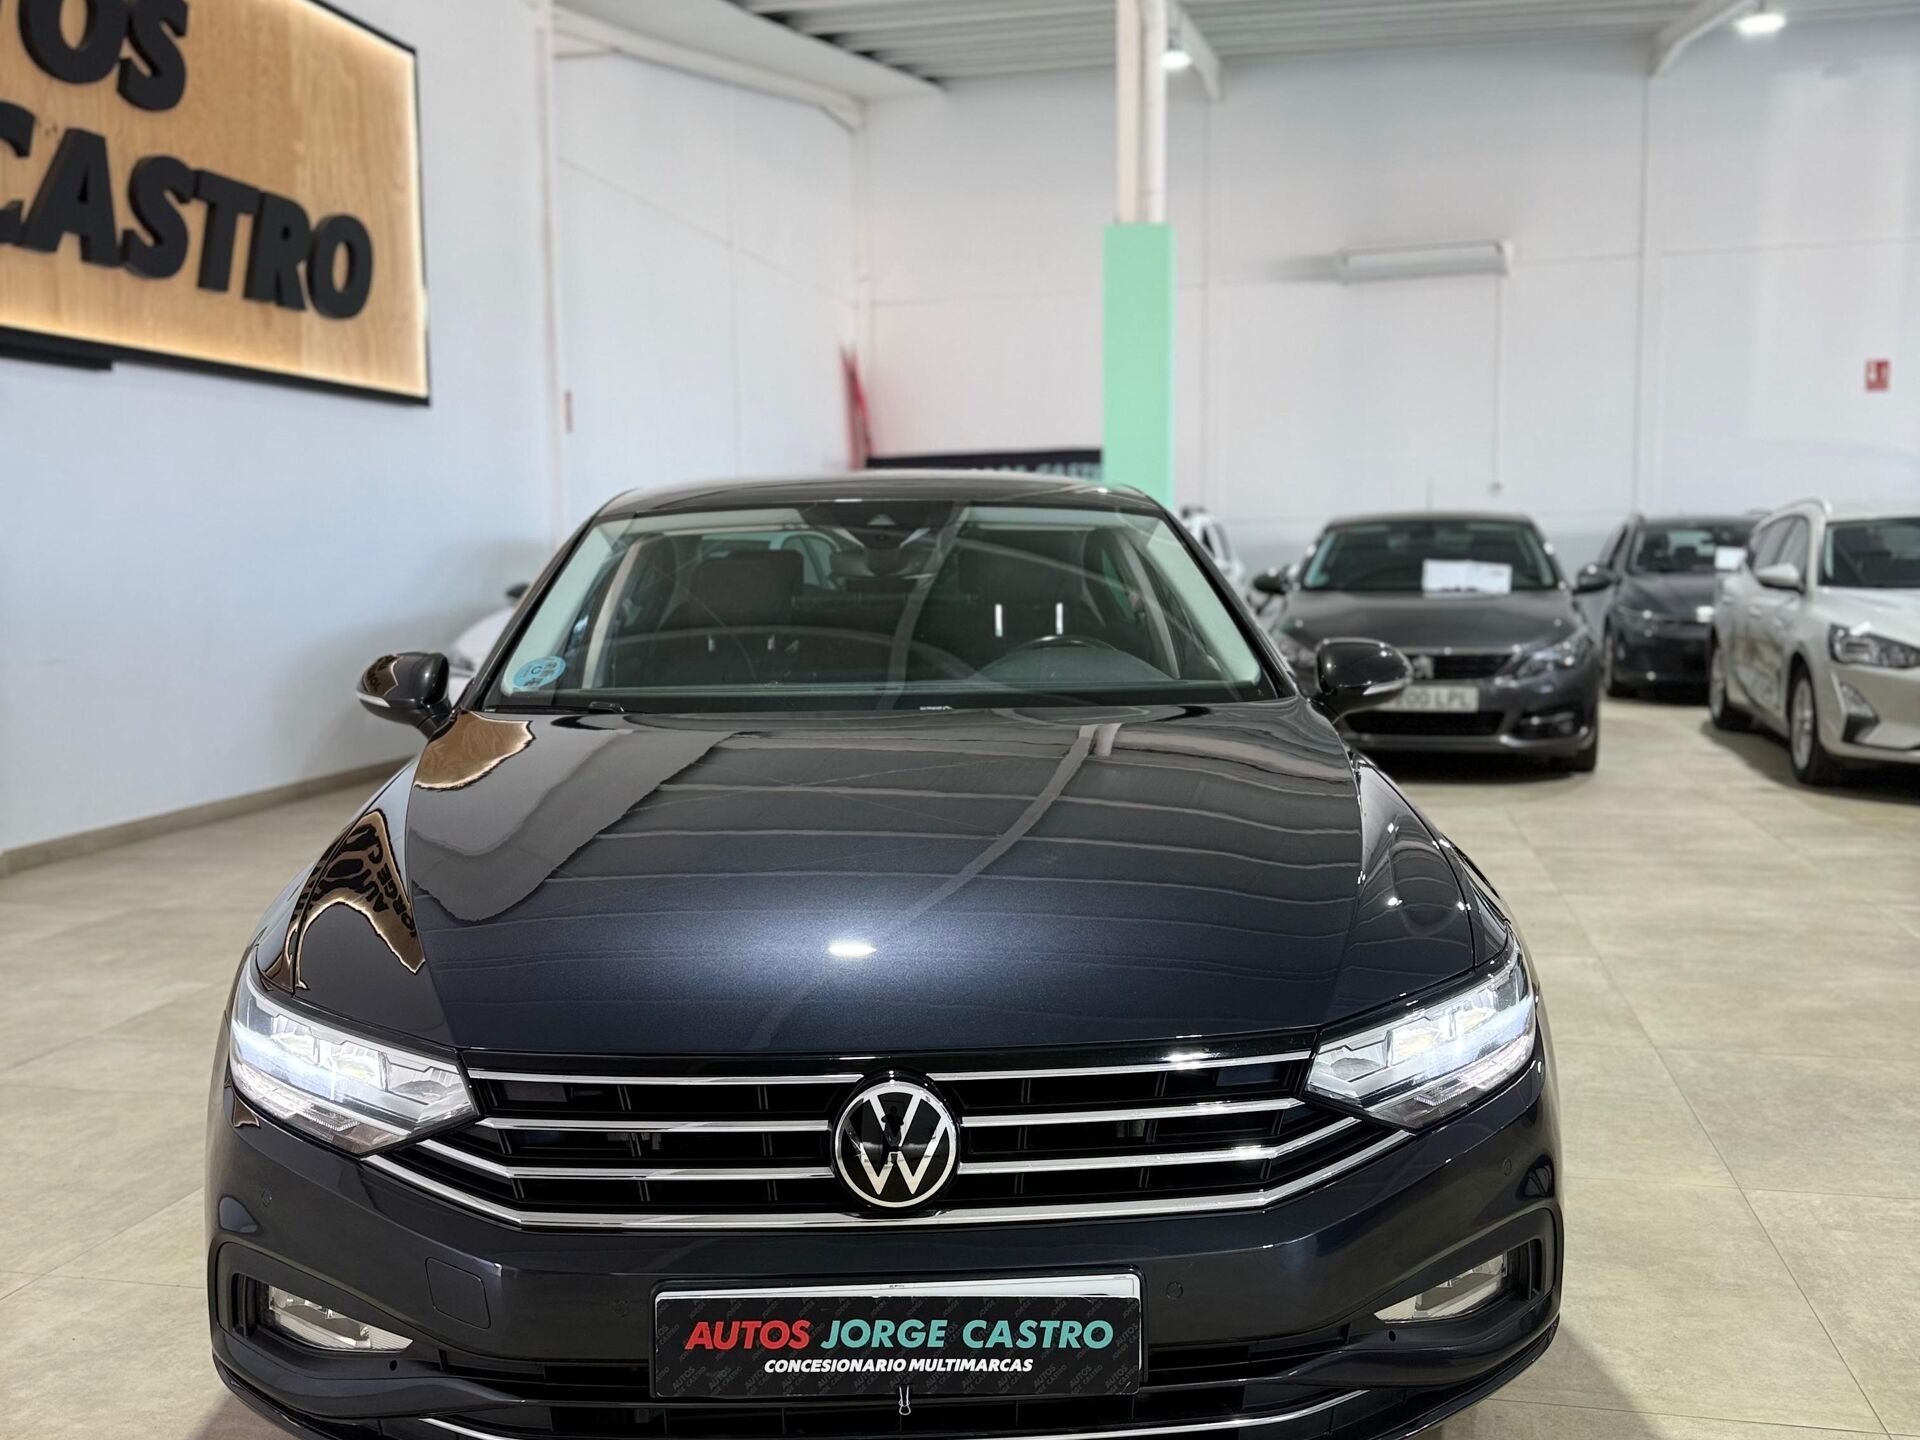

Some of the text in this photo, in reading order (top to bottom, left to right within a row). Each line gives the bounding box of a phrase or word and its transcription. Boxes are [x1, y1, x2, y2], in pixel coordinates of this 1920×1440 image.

[685, 1319, 811, 1350] AUTOS
[820, 1319, 948, 1349] JORGE
[963, 1319, 1114, 1349] CASTRO
[764, 1358, 1034, 1374] CONCESIONARIO MULTIMARCAS
